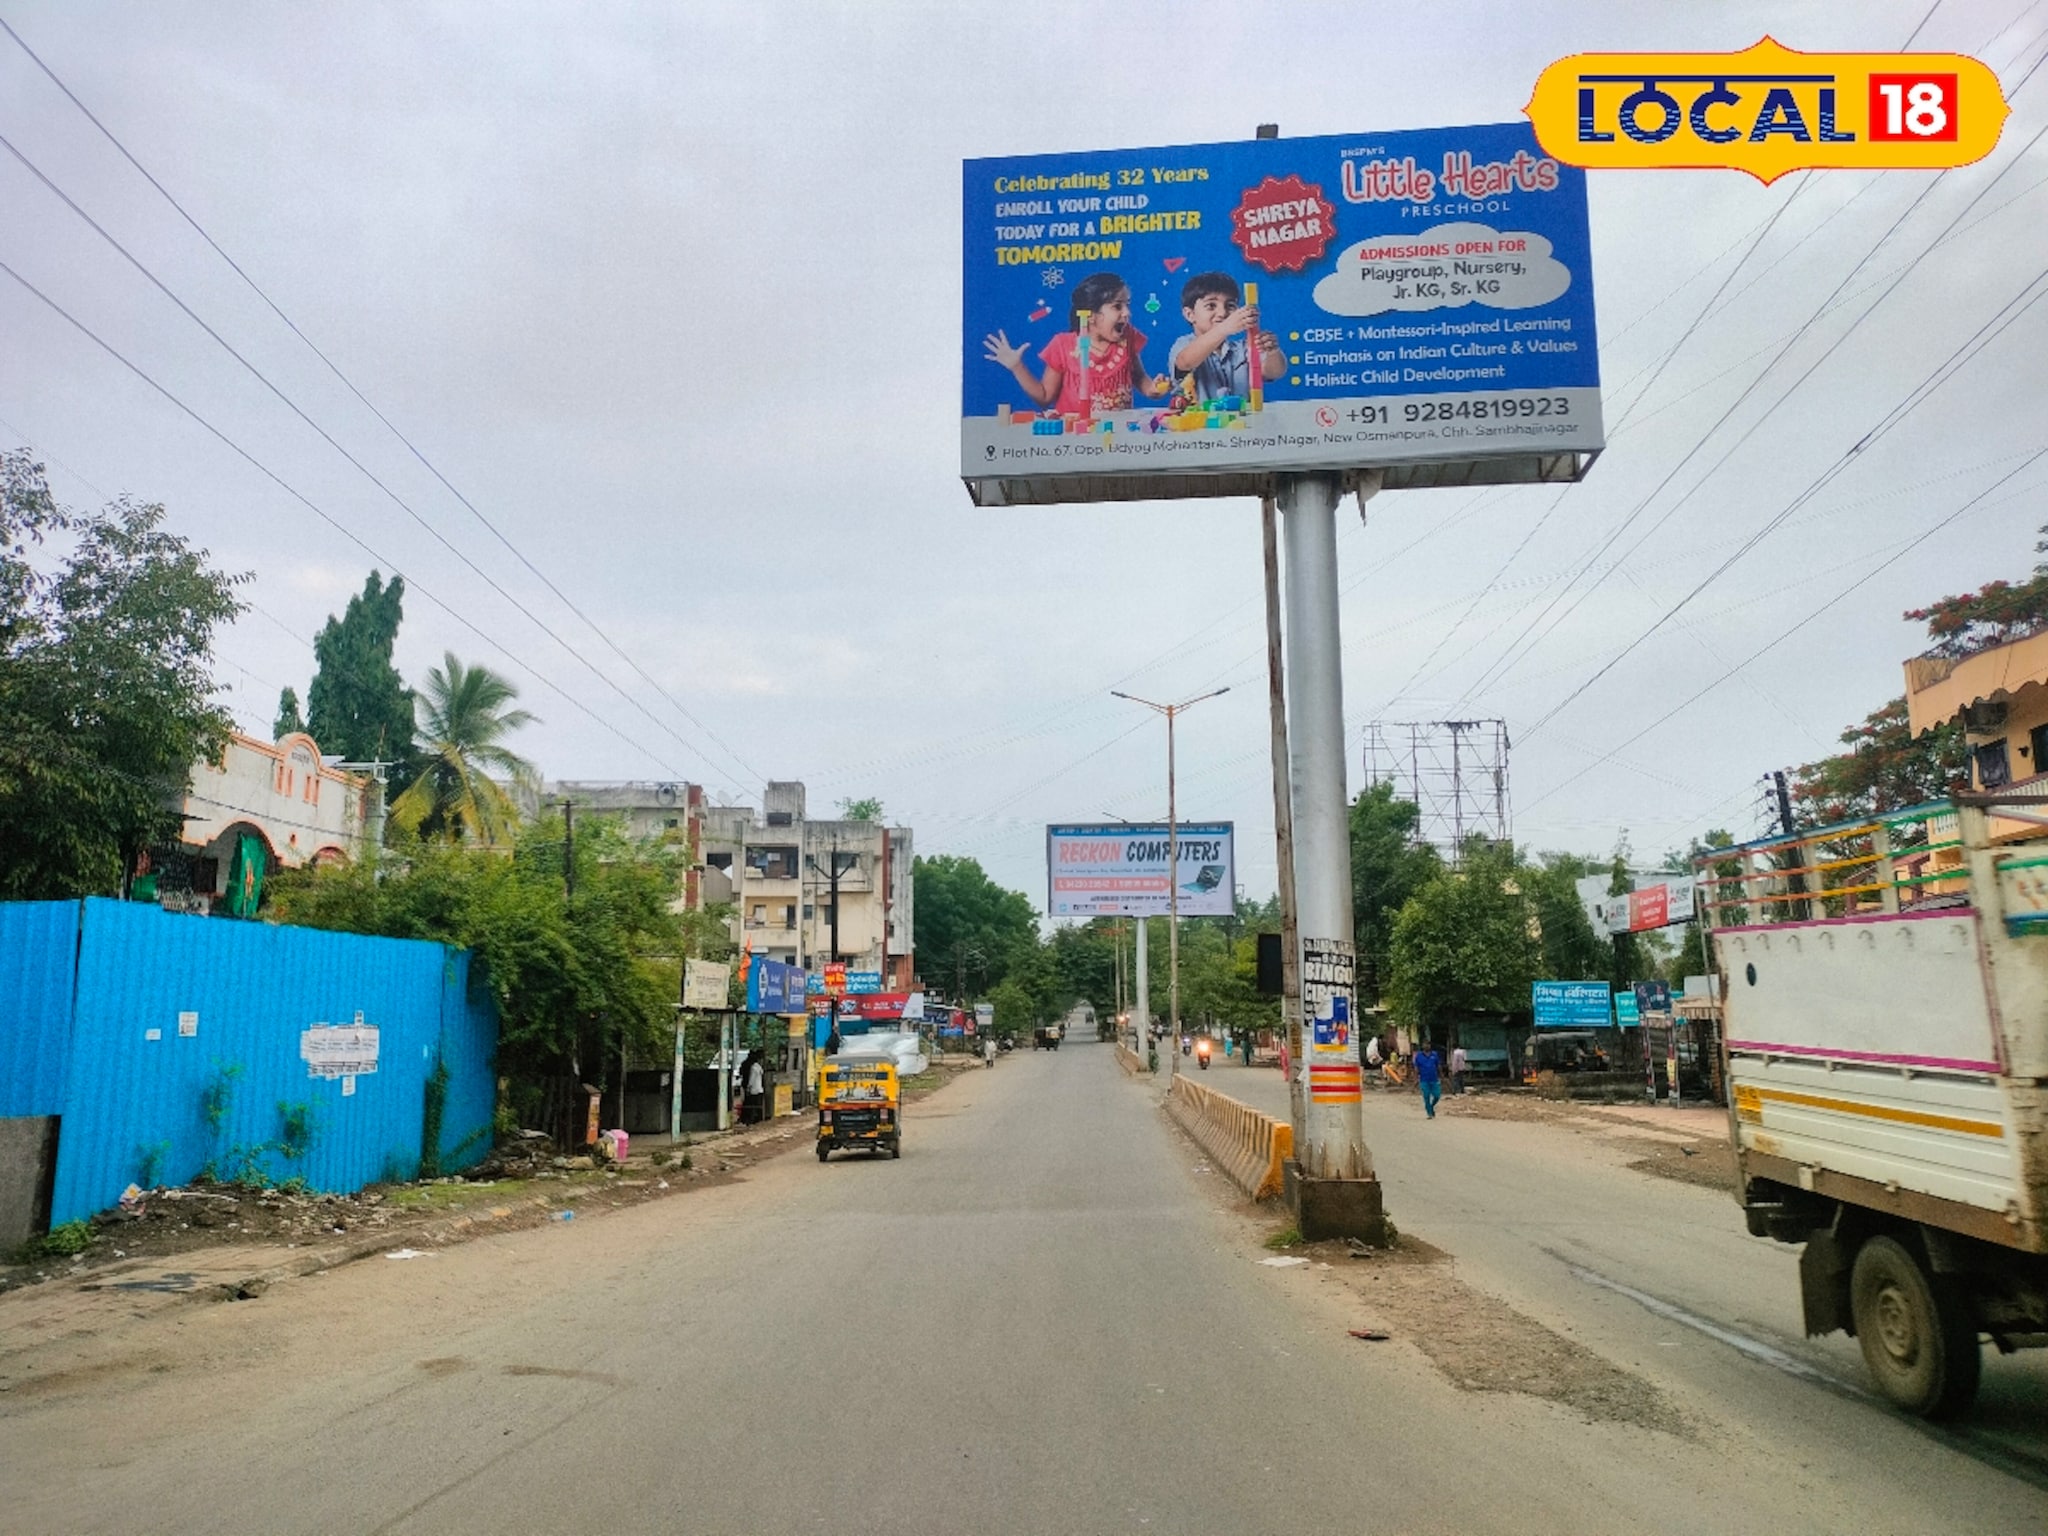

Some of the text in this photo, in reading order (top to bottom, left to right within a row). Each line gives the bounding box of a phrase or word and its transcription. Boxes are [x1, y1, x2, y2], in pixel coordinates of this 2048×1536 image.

[994, 167, 1209, 193] Celebrating 32 Years
[1342, 151, 1558, 202] Little Hearts
[995, 194, 1149, 218] ENROLL YOUR CHILD
[1244, 198, 1322, 228] SHREYA
[1402, 202, 1511, 218] PRESCHOOL
[995, 211, 1201, 240] TODAY FOR A BRIGHTER
[1250, 219, 1322, 248] NAGAR
[995, 240, 1122, 265] TOMORROW
[1359, 239, 1526, 260] ADMISSIONS OPEN FOR
[1361, 261, 1527, 283] Playgroup, Nursery,
[1393, 280, 1500, 299] Jr. KG, Sr. KG
[1304, 317, 1571, 342] CBSE + Montessori-Inspired Learning
[1304, 339, 1578, 366] Emphasis on Indian Culture & Values
[1304, 365, 1506, 387] Holistic Child Development
[1346, 397, 1570, 424] +91 9284819923
[1002, 448, 1028, 458] Plot
[1230, 436, 1275, 450] Shreya
[1278, 435, 1320, 447] Nagar,
[1324, 433, 1352, 443] New
[1476, 422, 1579, 436] Sambhajinagar
[1059, 841, 1221, 863] RECKON COMPUTERS
[1304, 961, 1353, 985] BINGO
